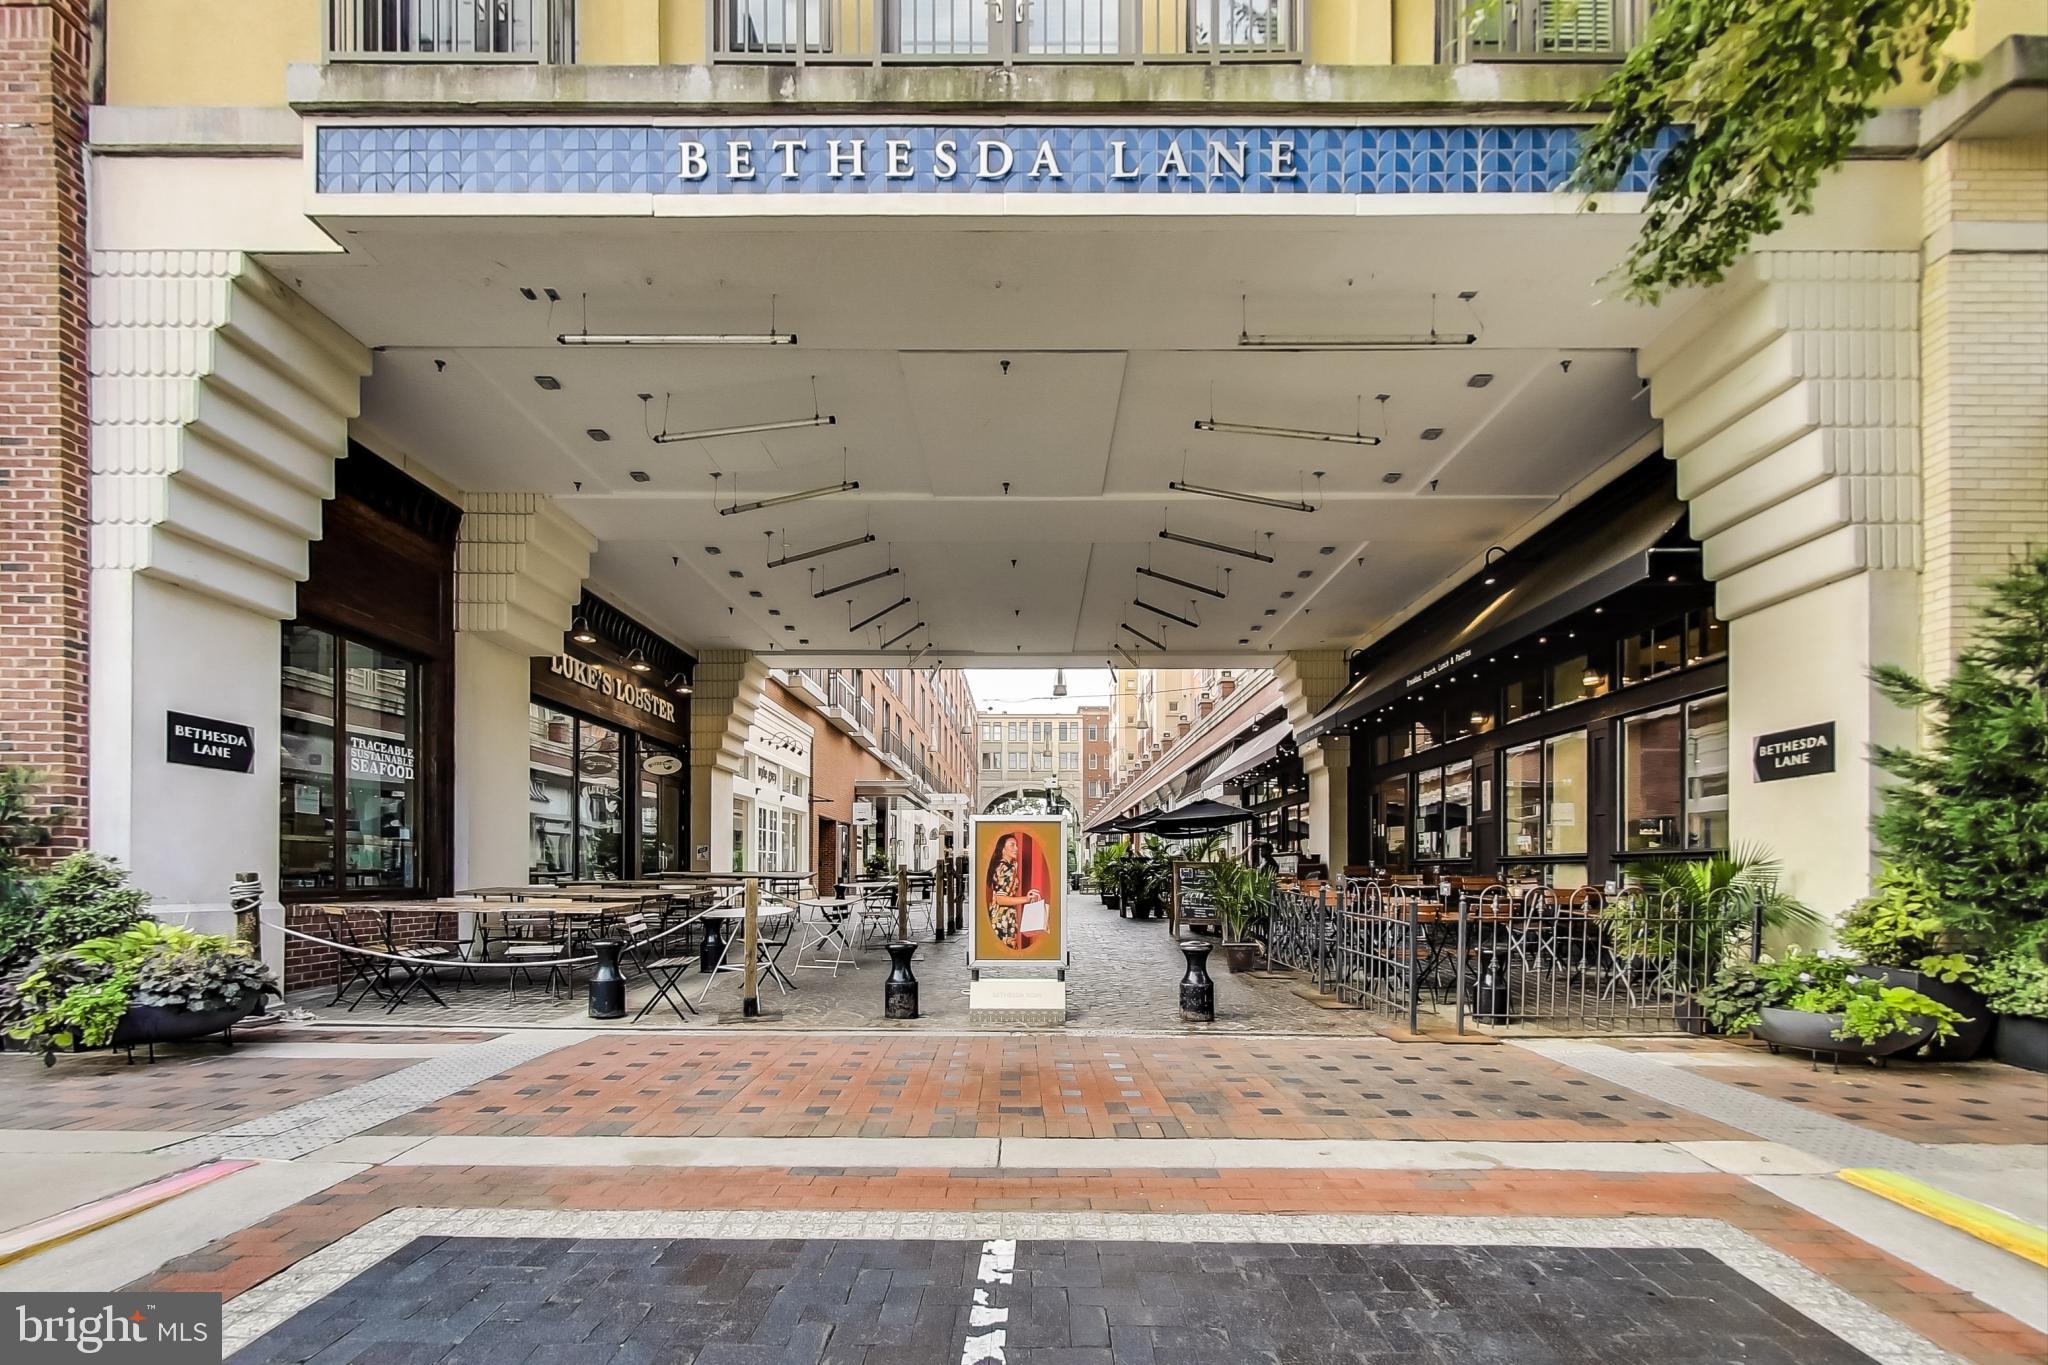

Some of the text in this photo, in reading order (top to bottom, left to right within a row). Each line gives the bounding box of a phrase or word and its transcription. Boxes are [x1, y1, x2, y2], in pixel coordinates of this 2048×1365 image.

[678, 139, 1298, 181] BETHESDA LANE
[551, 653, 676, 724] LUKE'S LOBSTER
[174, 725, 248, 748] BETHESDA
[351, 736, 415, 759] TRACEABLE
[1759, 735, 1828, 757] BETHESDA
[193, 743, 232, 759] LANE
[351, 749, 415, 768] SUSTAINABLE
[1774, 752, 1811, 769] LANE
[351, 757, 415, 780] SEAFOOD
